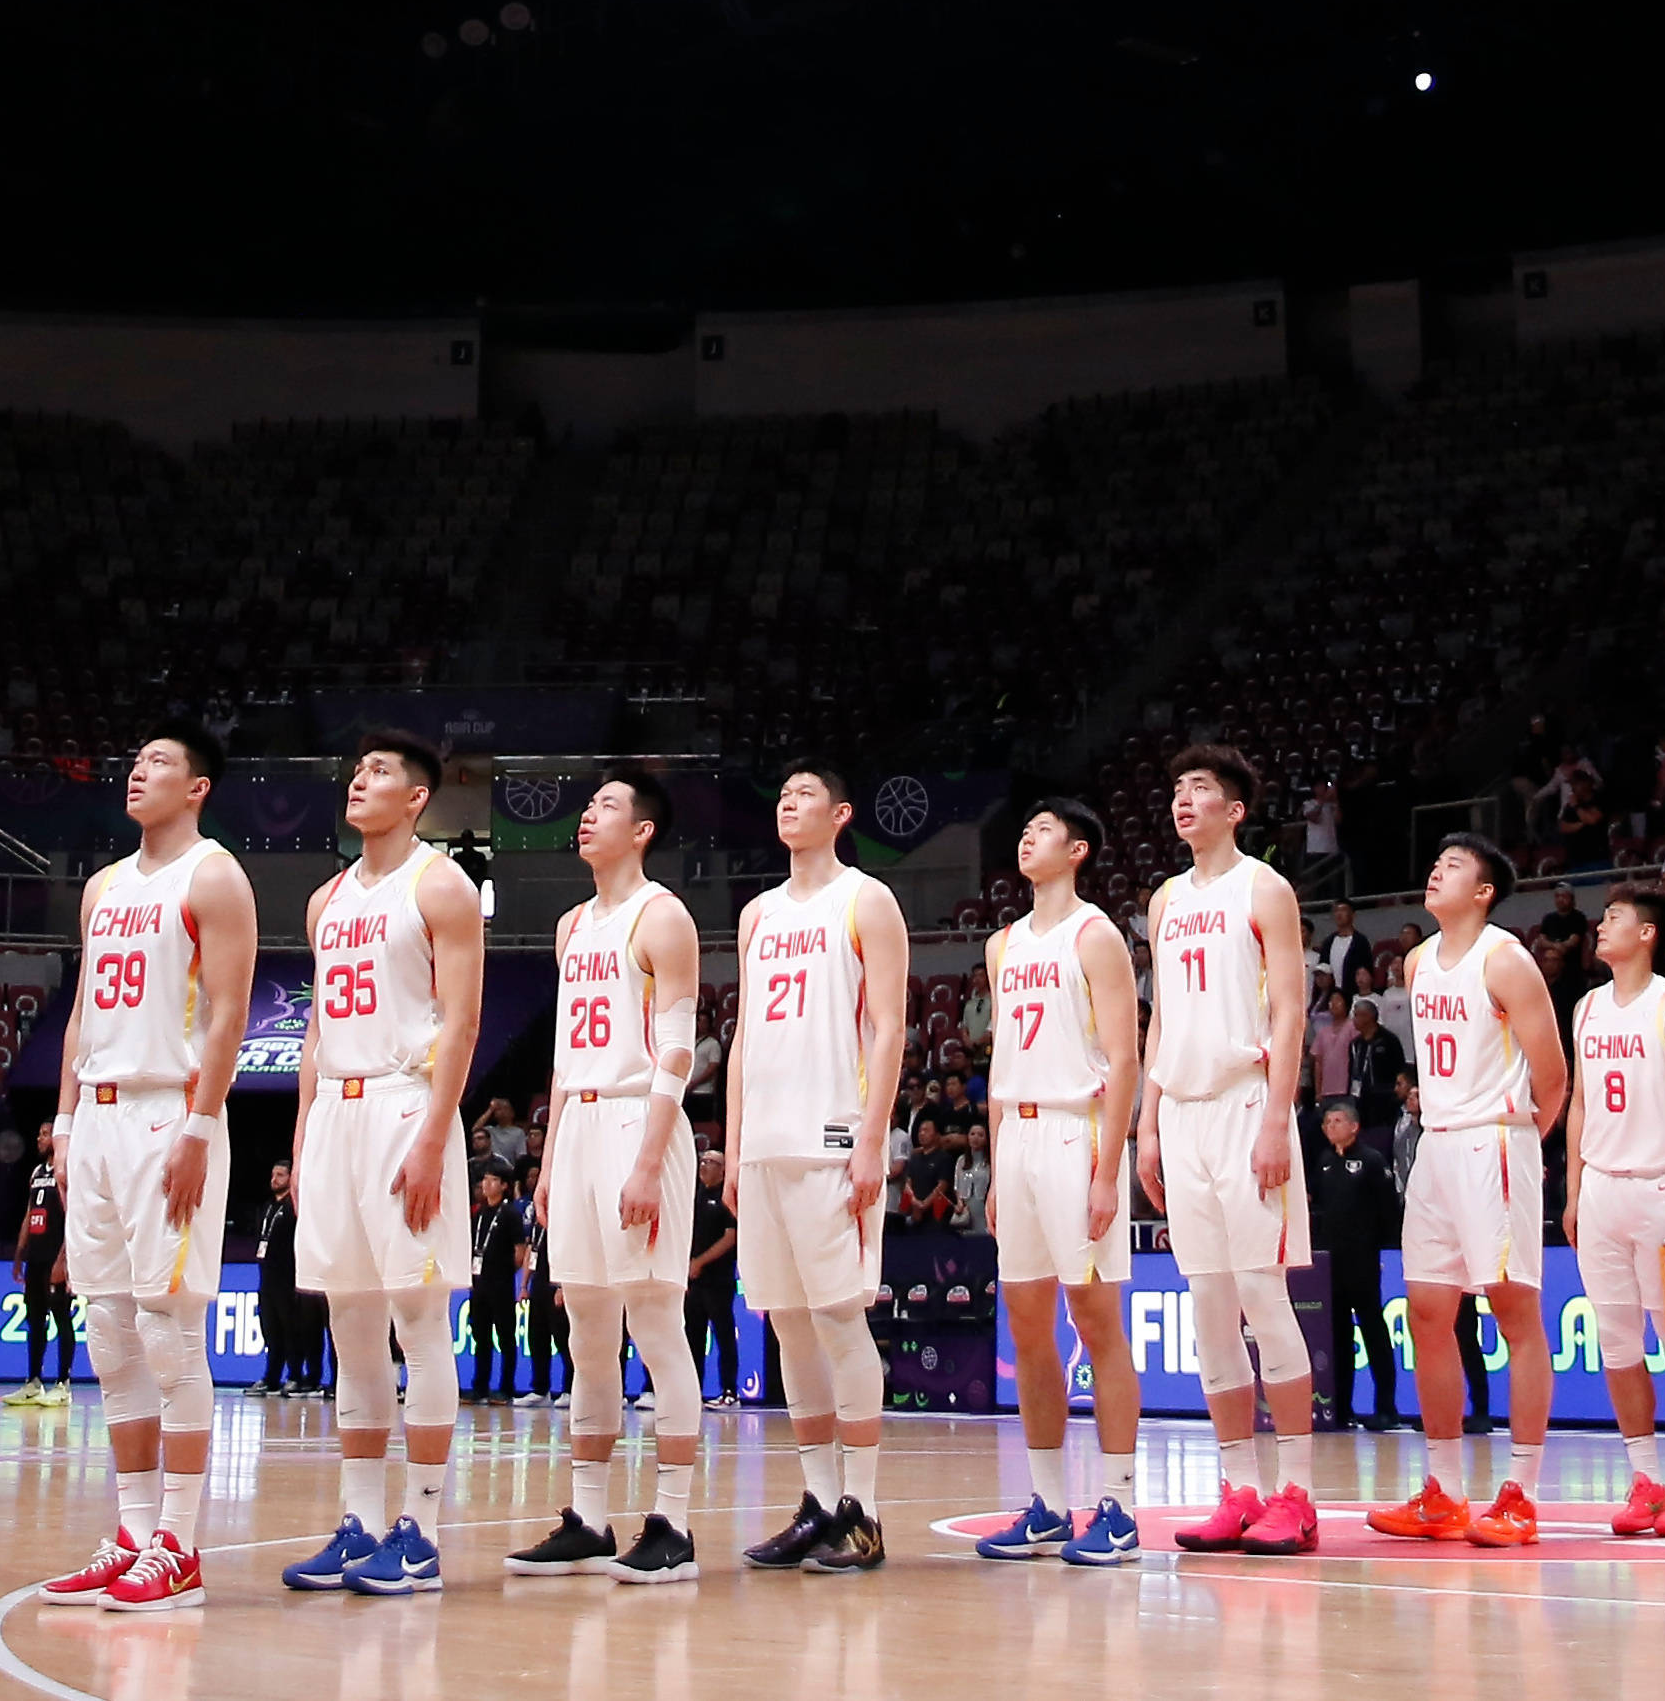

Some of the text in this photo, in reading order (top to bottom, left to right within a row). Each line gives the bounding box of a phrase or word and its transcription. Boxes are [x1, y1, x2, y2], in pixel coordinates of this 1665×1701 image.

[759, 926, 827, 961] CHINA
[1164, 910, 1226, 942] CHINA
[94, 950, 147, 1010] 39
[325, 959, 378, 1019] 35
[1180, 947, 1206, 993] 11
[766, 968, 807, 1022] 21
[1415, 993, 1469, 1022] CHINA
[570, 995, 611, 1049] 26
[1011, 1001, 1044, 1051] 17
[1424, 1032, 1457, 1078] 10
[1584, 1034, 1646, 1060] CHINA
[1604, 1070, 1626, 1113] 8
[36, 1189, 45, 1206] 0
